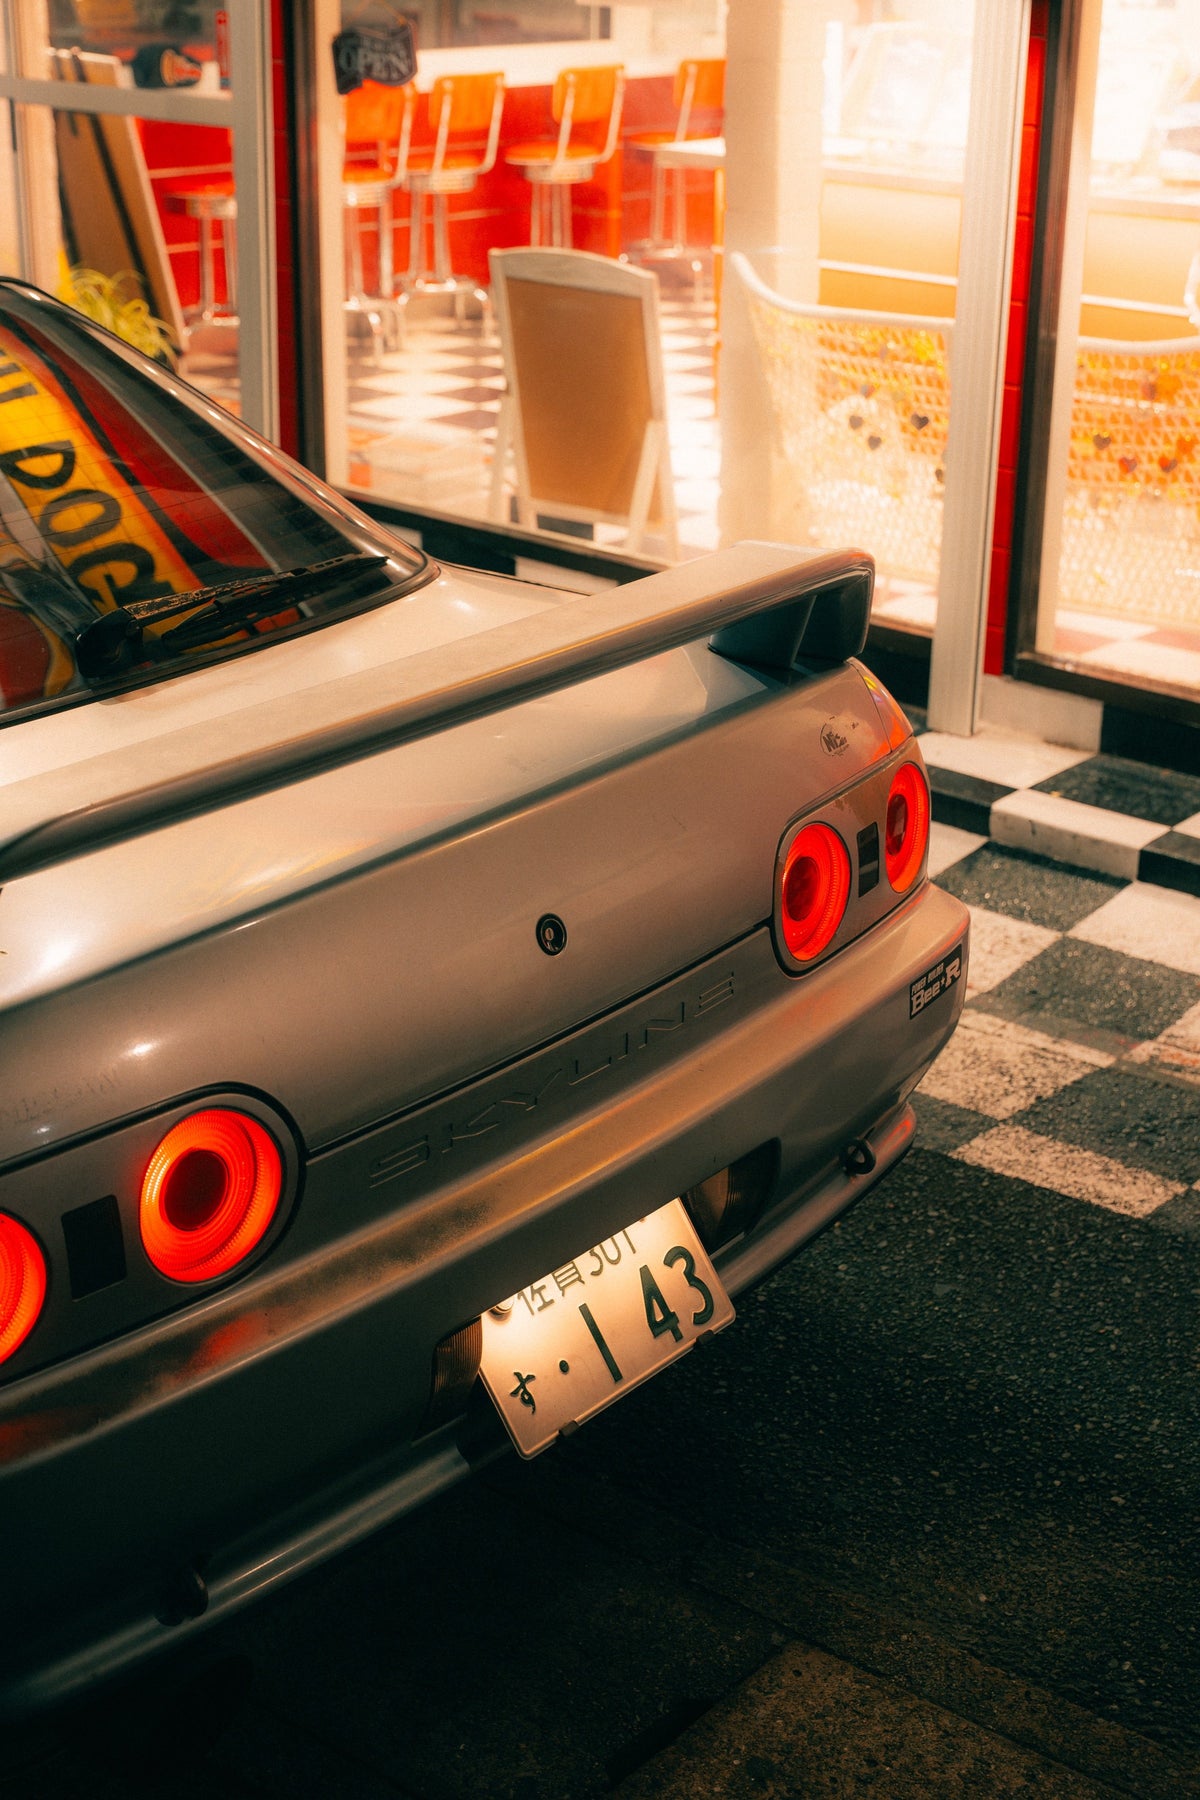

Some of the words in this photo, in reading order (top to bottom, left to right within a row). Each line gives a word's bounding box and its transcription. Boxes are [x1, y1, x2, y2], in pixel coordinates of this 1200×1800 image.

[338, 43, 410, 79] OPEN
[369, 971, 735, 1188] SKYLINE
[509, 1371, 537, 1415] す
